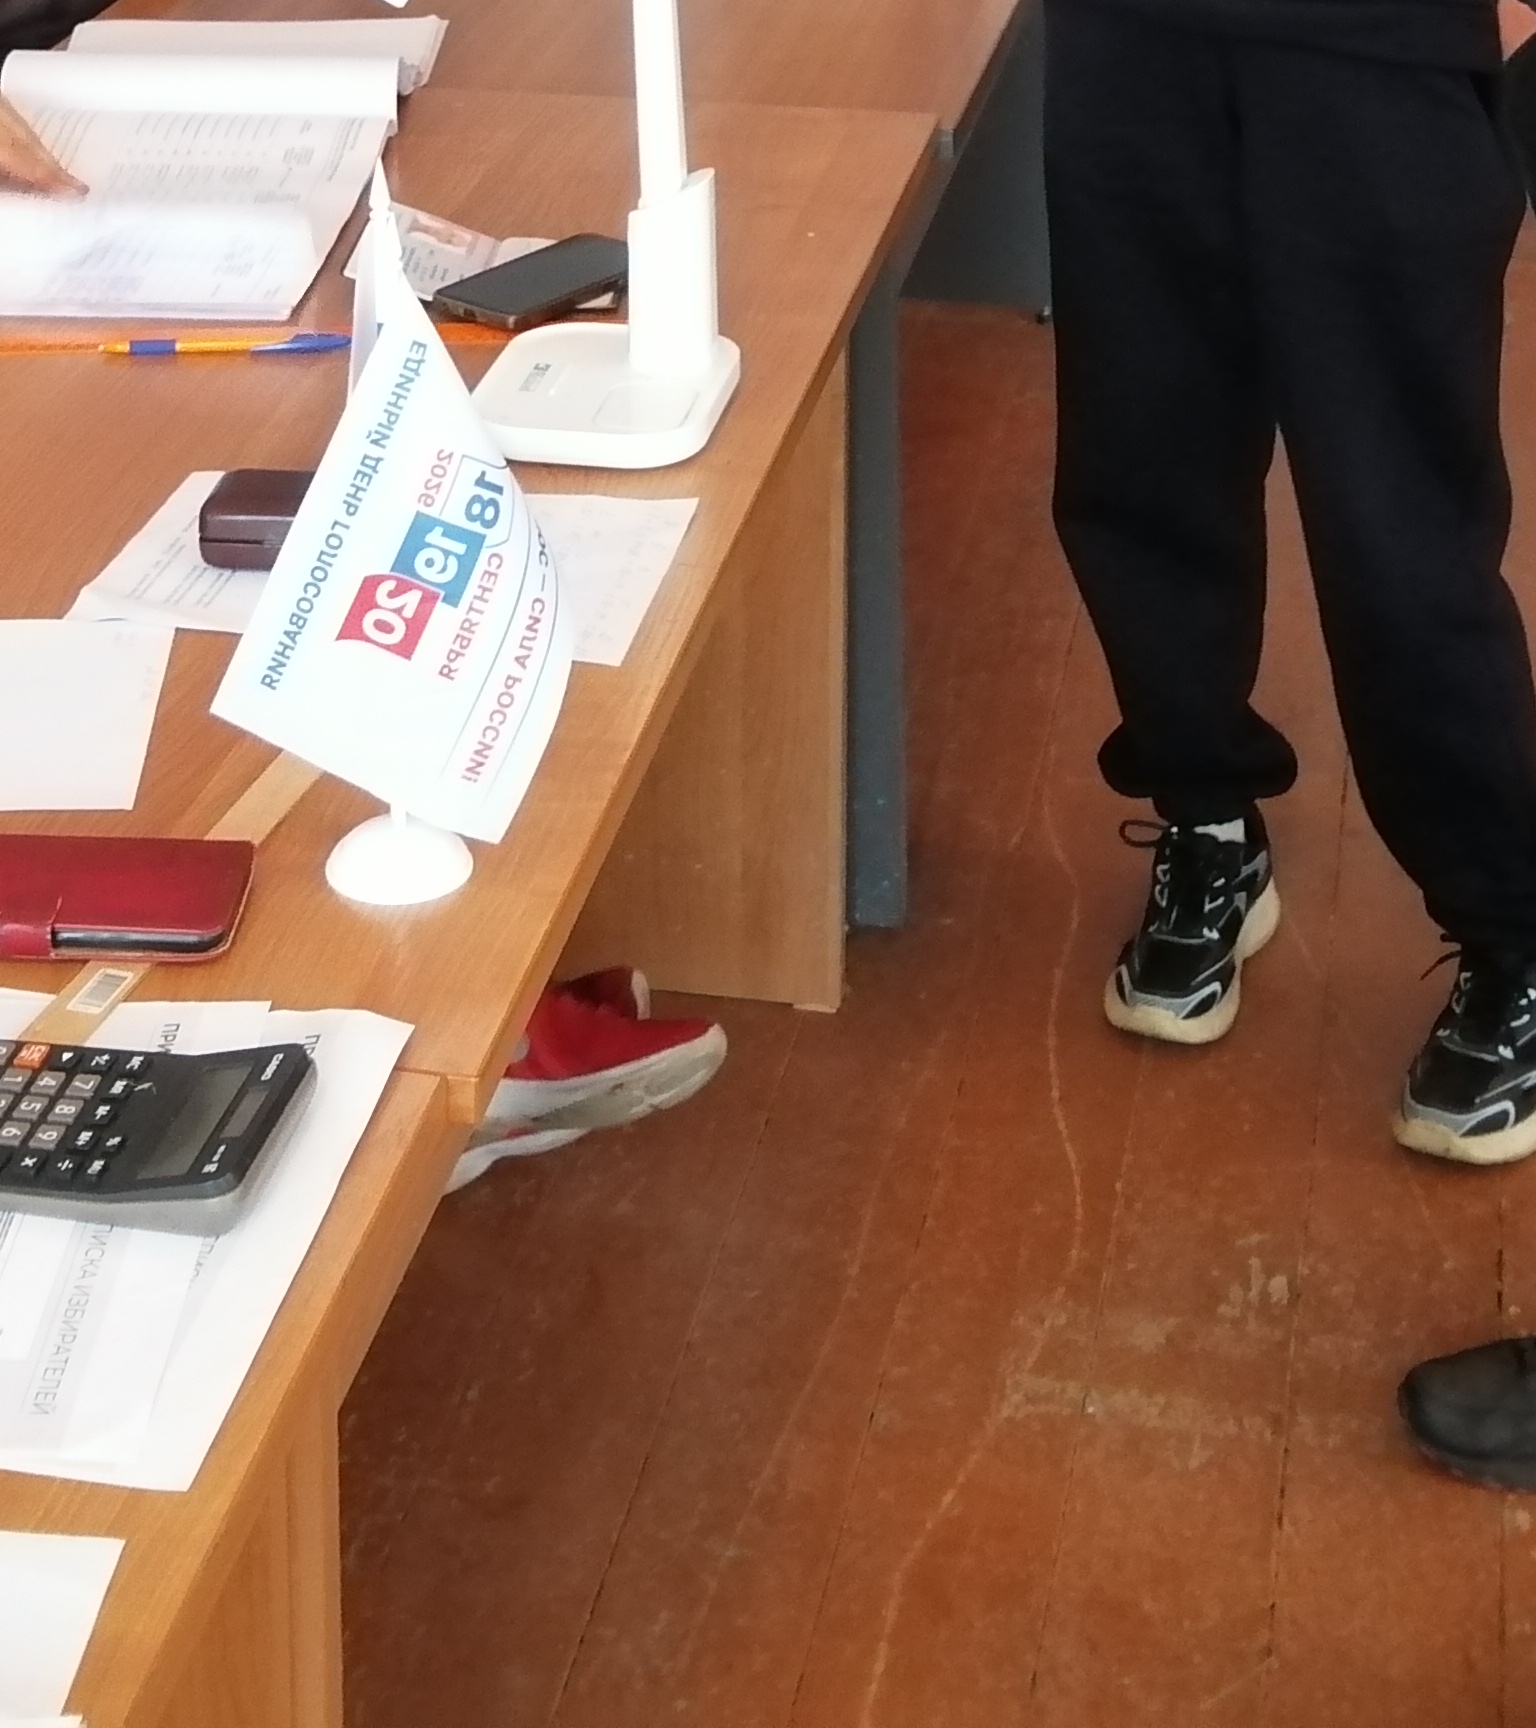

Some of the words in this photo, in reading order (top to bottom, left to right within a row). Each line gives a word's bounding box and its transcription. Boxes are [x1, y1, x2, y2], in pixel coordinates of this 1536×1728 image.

[37, 1076, 57, 1087] 4
[73, 1079, 95, 1092] 7
[20, 1101, 42, 1112] 5
[54, 1104, 76, 1115] 8
[1, 1127, 22, 1138] 6
[37, 1130, 58, 1141] 9
[30, 1284, 94, 1416] ИЗБИРАТЕЛЕЙ
